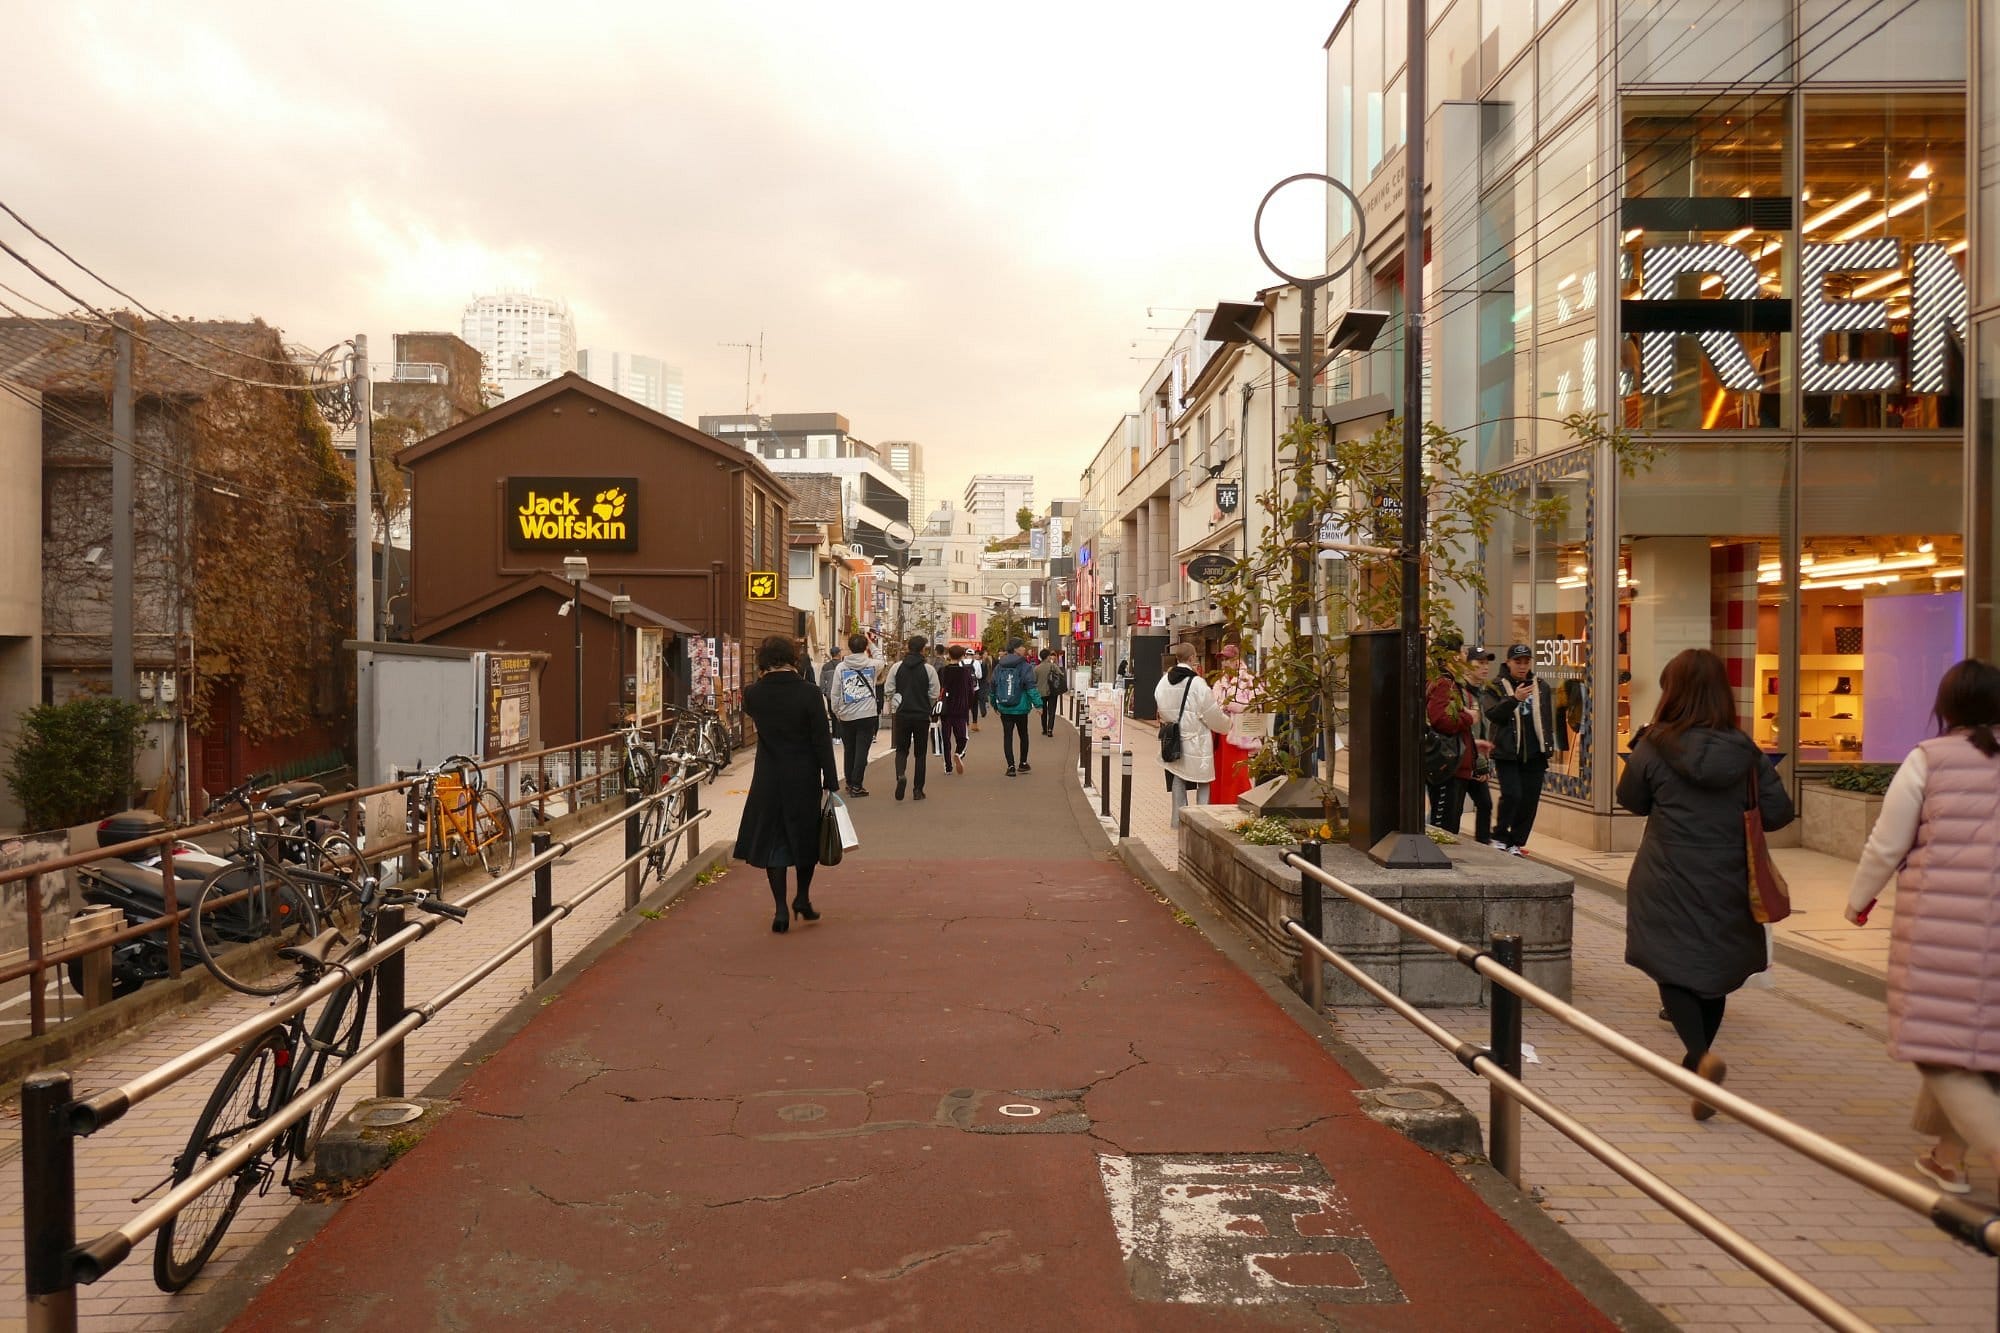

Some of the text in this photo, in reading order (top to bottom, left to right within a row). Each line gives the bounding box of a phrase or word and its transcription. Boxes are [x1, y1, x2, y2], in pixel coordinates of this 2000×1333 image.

[518, 491, 581, 516] Jack
[518, 515, 626, 540] Wolfskin
[1536, 639, 1583, 666] ESPRIT
